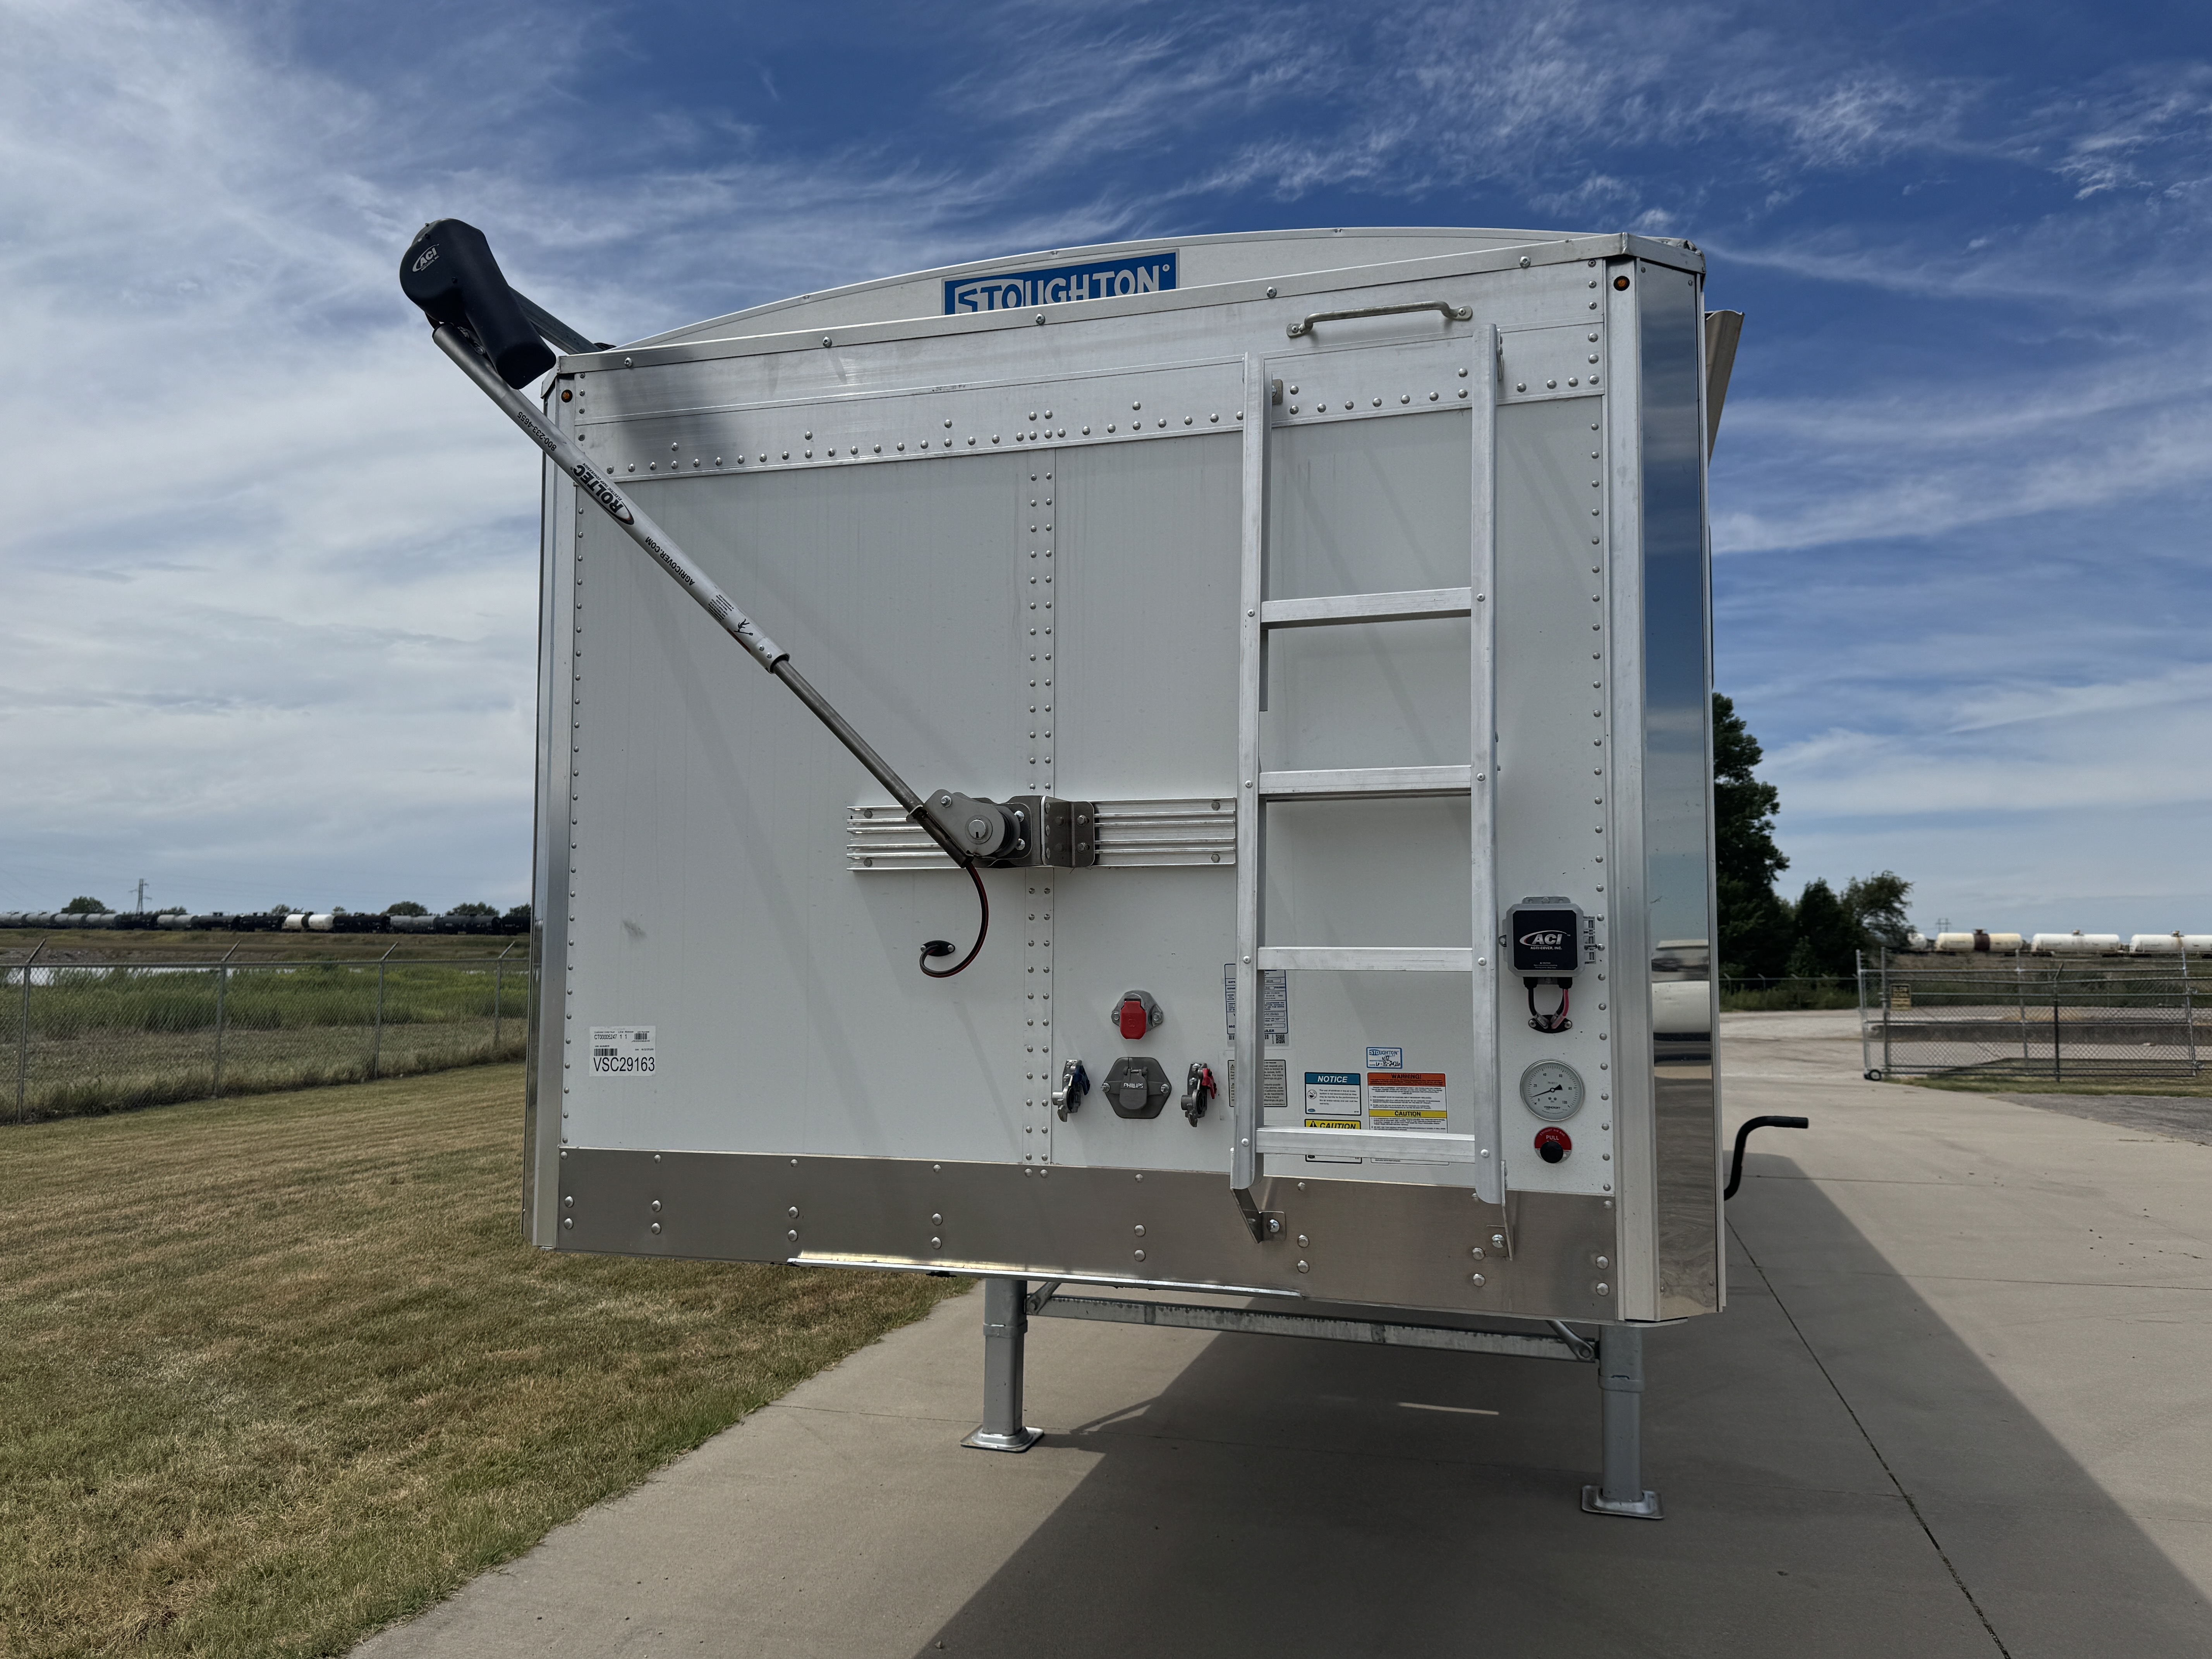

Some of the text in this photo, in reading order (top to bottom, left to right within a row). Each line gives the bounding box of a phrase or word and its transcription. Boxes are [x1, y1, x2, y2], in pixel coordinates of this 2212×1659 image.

[517, 412, 556, 451] 800-233-4655
[573, 465, 624, 514] ROLTEC
[607, 487, 622, 501] ELECTRIC
[645, 536, 695, 586] AGRICOVER.COM
[1532, 934, 1562, 945] ACI
[593, 1056, 655, 1072] VSC29163
